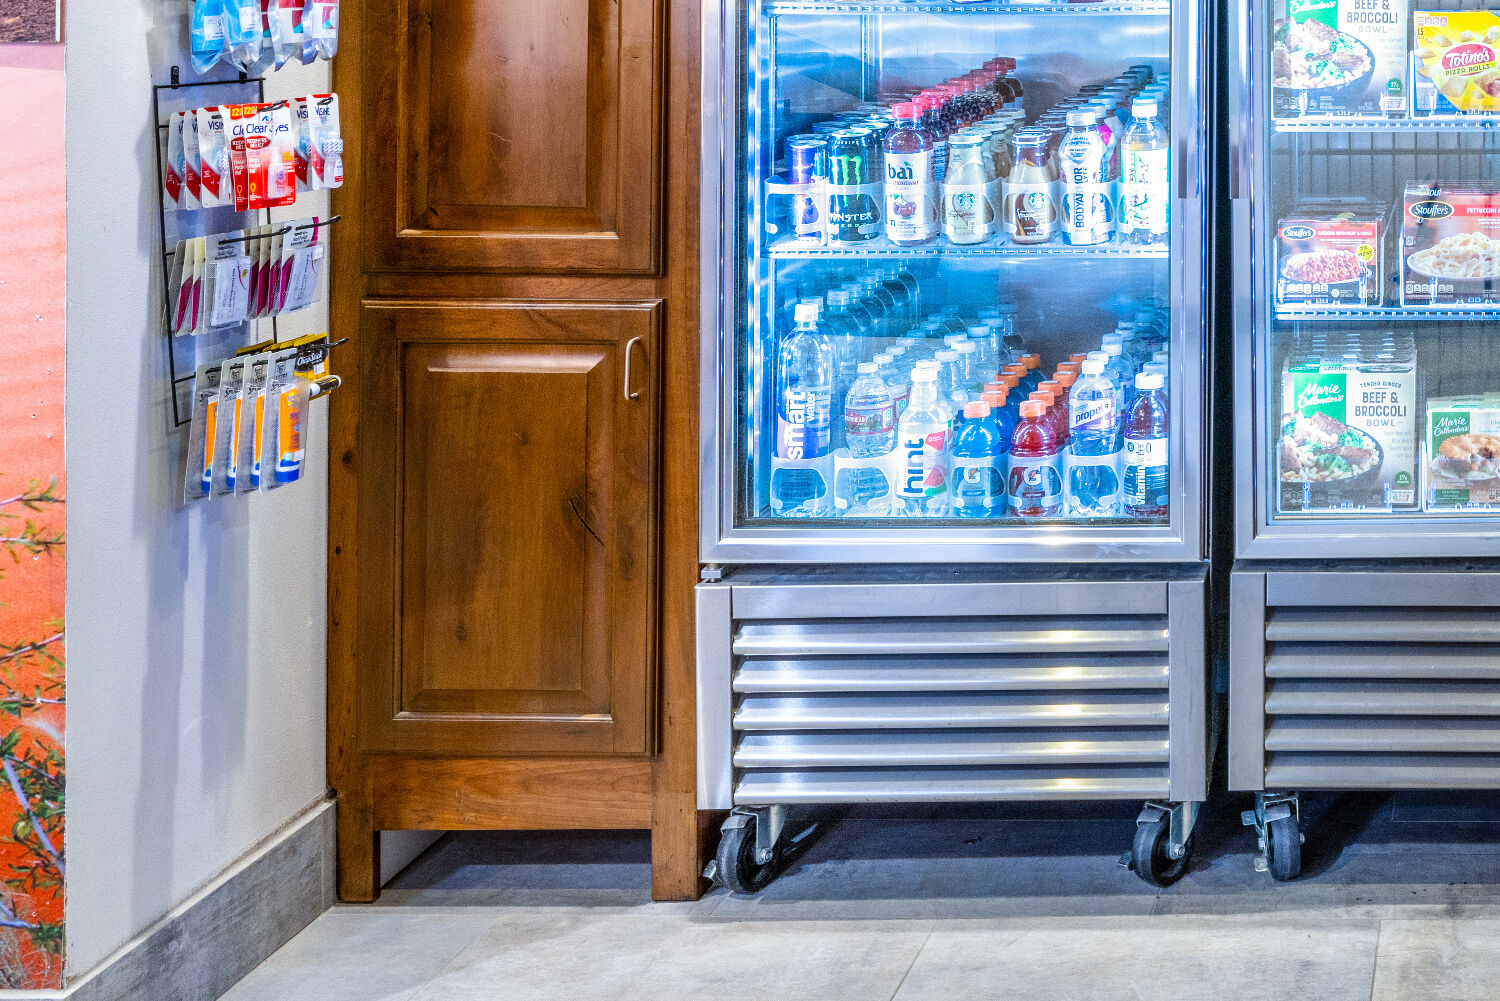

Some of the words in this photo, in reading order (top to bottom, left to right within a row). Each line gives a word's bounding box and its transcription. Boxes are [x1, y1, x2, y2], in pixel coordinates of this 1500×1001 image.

[1354, 0, 1378, 10] BEEF
[1382, 0, 1390, 10] &
[1347, 12, 1398, 24] BROCCOLI
[1446, 48, 1490, 68] Totino's
[1445, 68, 1466, 76] PIZZA
[1468, 64, 1491, 73] ROLLS
[246, 123, 267, 134] Clear
[888, 161, 914, 179] bai
[1414, 204, 1449, 216] Stouffer's
[1285, 228, 1313, 238] Stouffer's
[1301, 384, 1340, 396] Marie
[1298, 395, 1345, 408] Callender's
[1362, 392, 1387, 403] BEEF
[1390, 392, 1399, 403] &
[806, 391, 816, 422] water
[1355, 405, 1407, 417] BROCCOLI
[787, 389, 805, 459] smart
[1438, 417, 1467, 428] Marie
[1434, 426, 1470, 437] Callender's
[904, 437, 924, 494] hint
